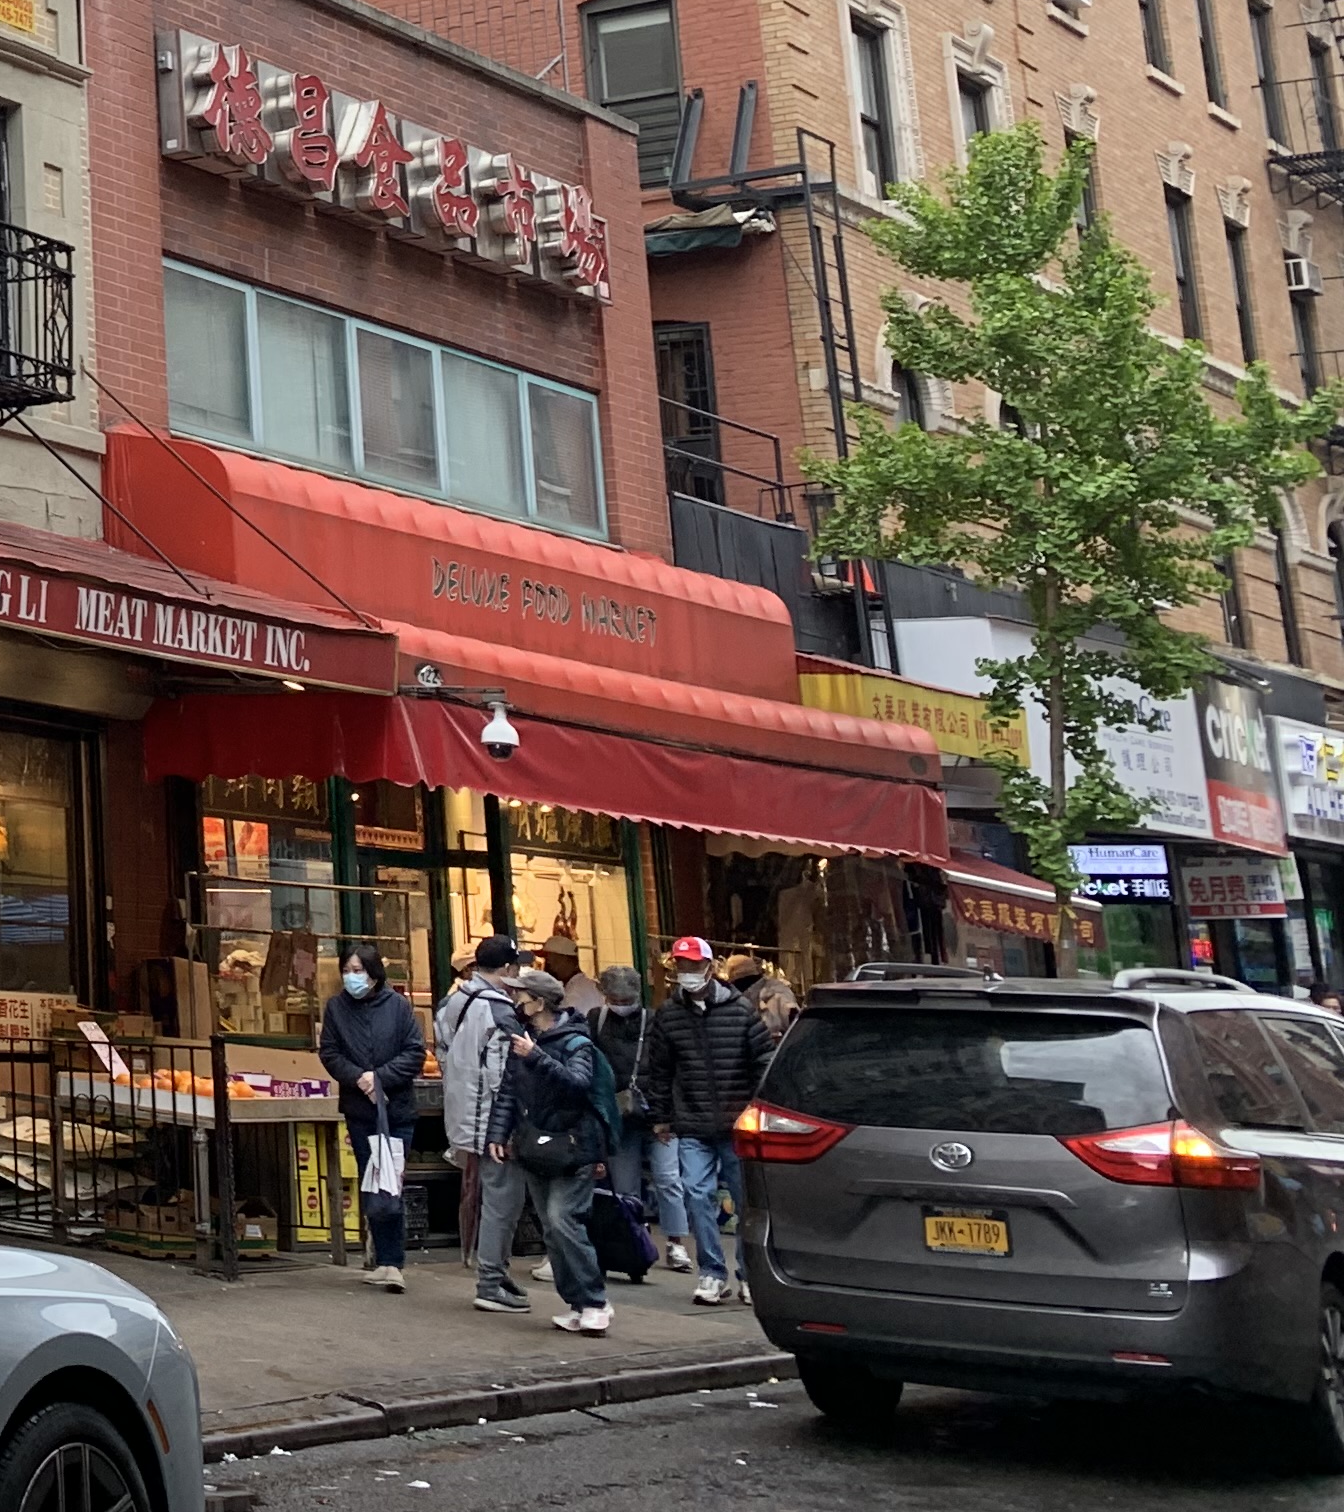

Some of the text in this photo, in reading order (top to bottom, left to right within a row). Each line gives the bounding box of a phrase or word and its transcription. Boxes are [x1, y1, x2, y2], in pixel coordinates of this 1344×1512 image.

[18, 574, 49, 625] LI
[76, 585, 148, 642] MEAT
[152, 601, 258, 663] MARKET
[263, 624, 311, 672] INC.
[431, 556, 658, 648] DELUXE FOOD MARKET
[1088, 847, 1159, 858] HumanCare
[932, 1220, 1001, 1244] JKK 1789
